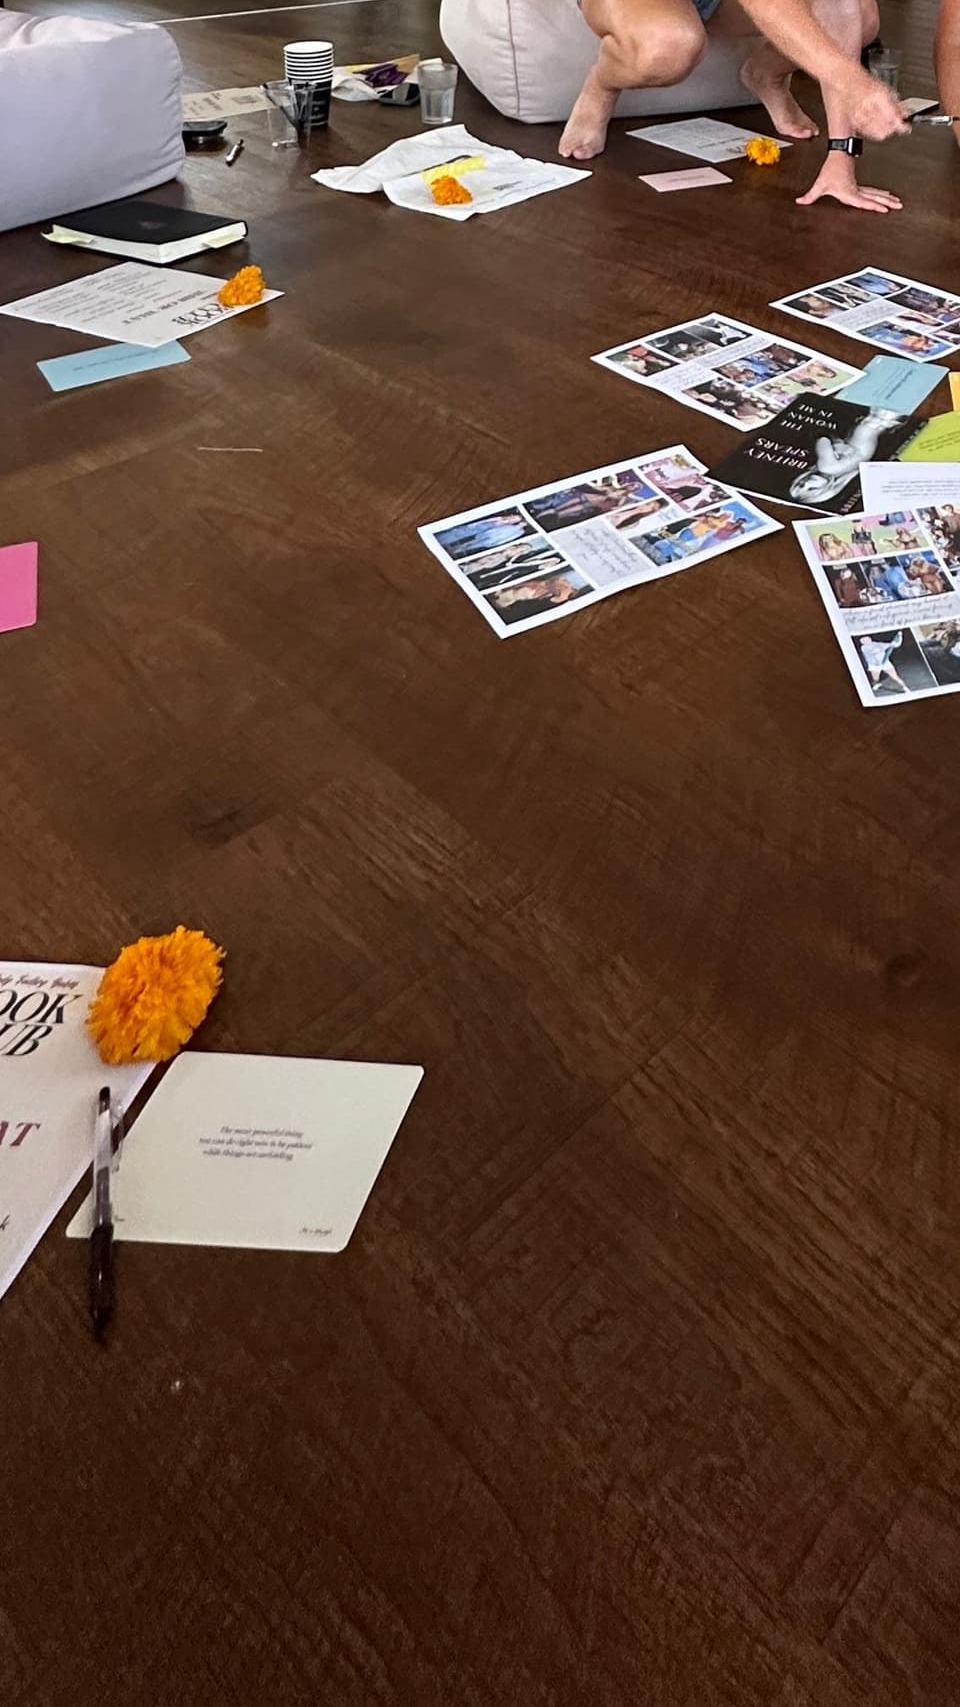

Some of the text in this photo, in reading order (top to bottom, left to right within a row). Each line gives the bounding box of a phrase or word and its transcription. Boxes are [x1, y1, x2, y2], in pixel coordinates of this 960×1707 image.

[789, 411, 837, 430] WOMAN
[819, 409, 833, 418] IN
[780, 420, 803, 431] THE
[756, 437, 809, 457] SPEARS
[744, 447, 808, 470] BRITNEY
[0, 989, 83, 1024] OOK
